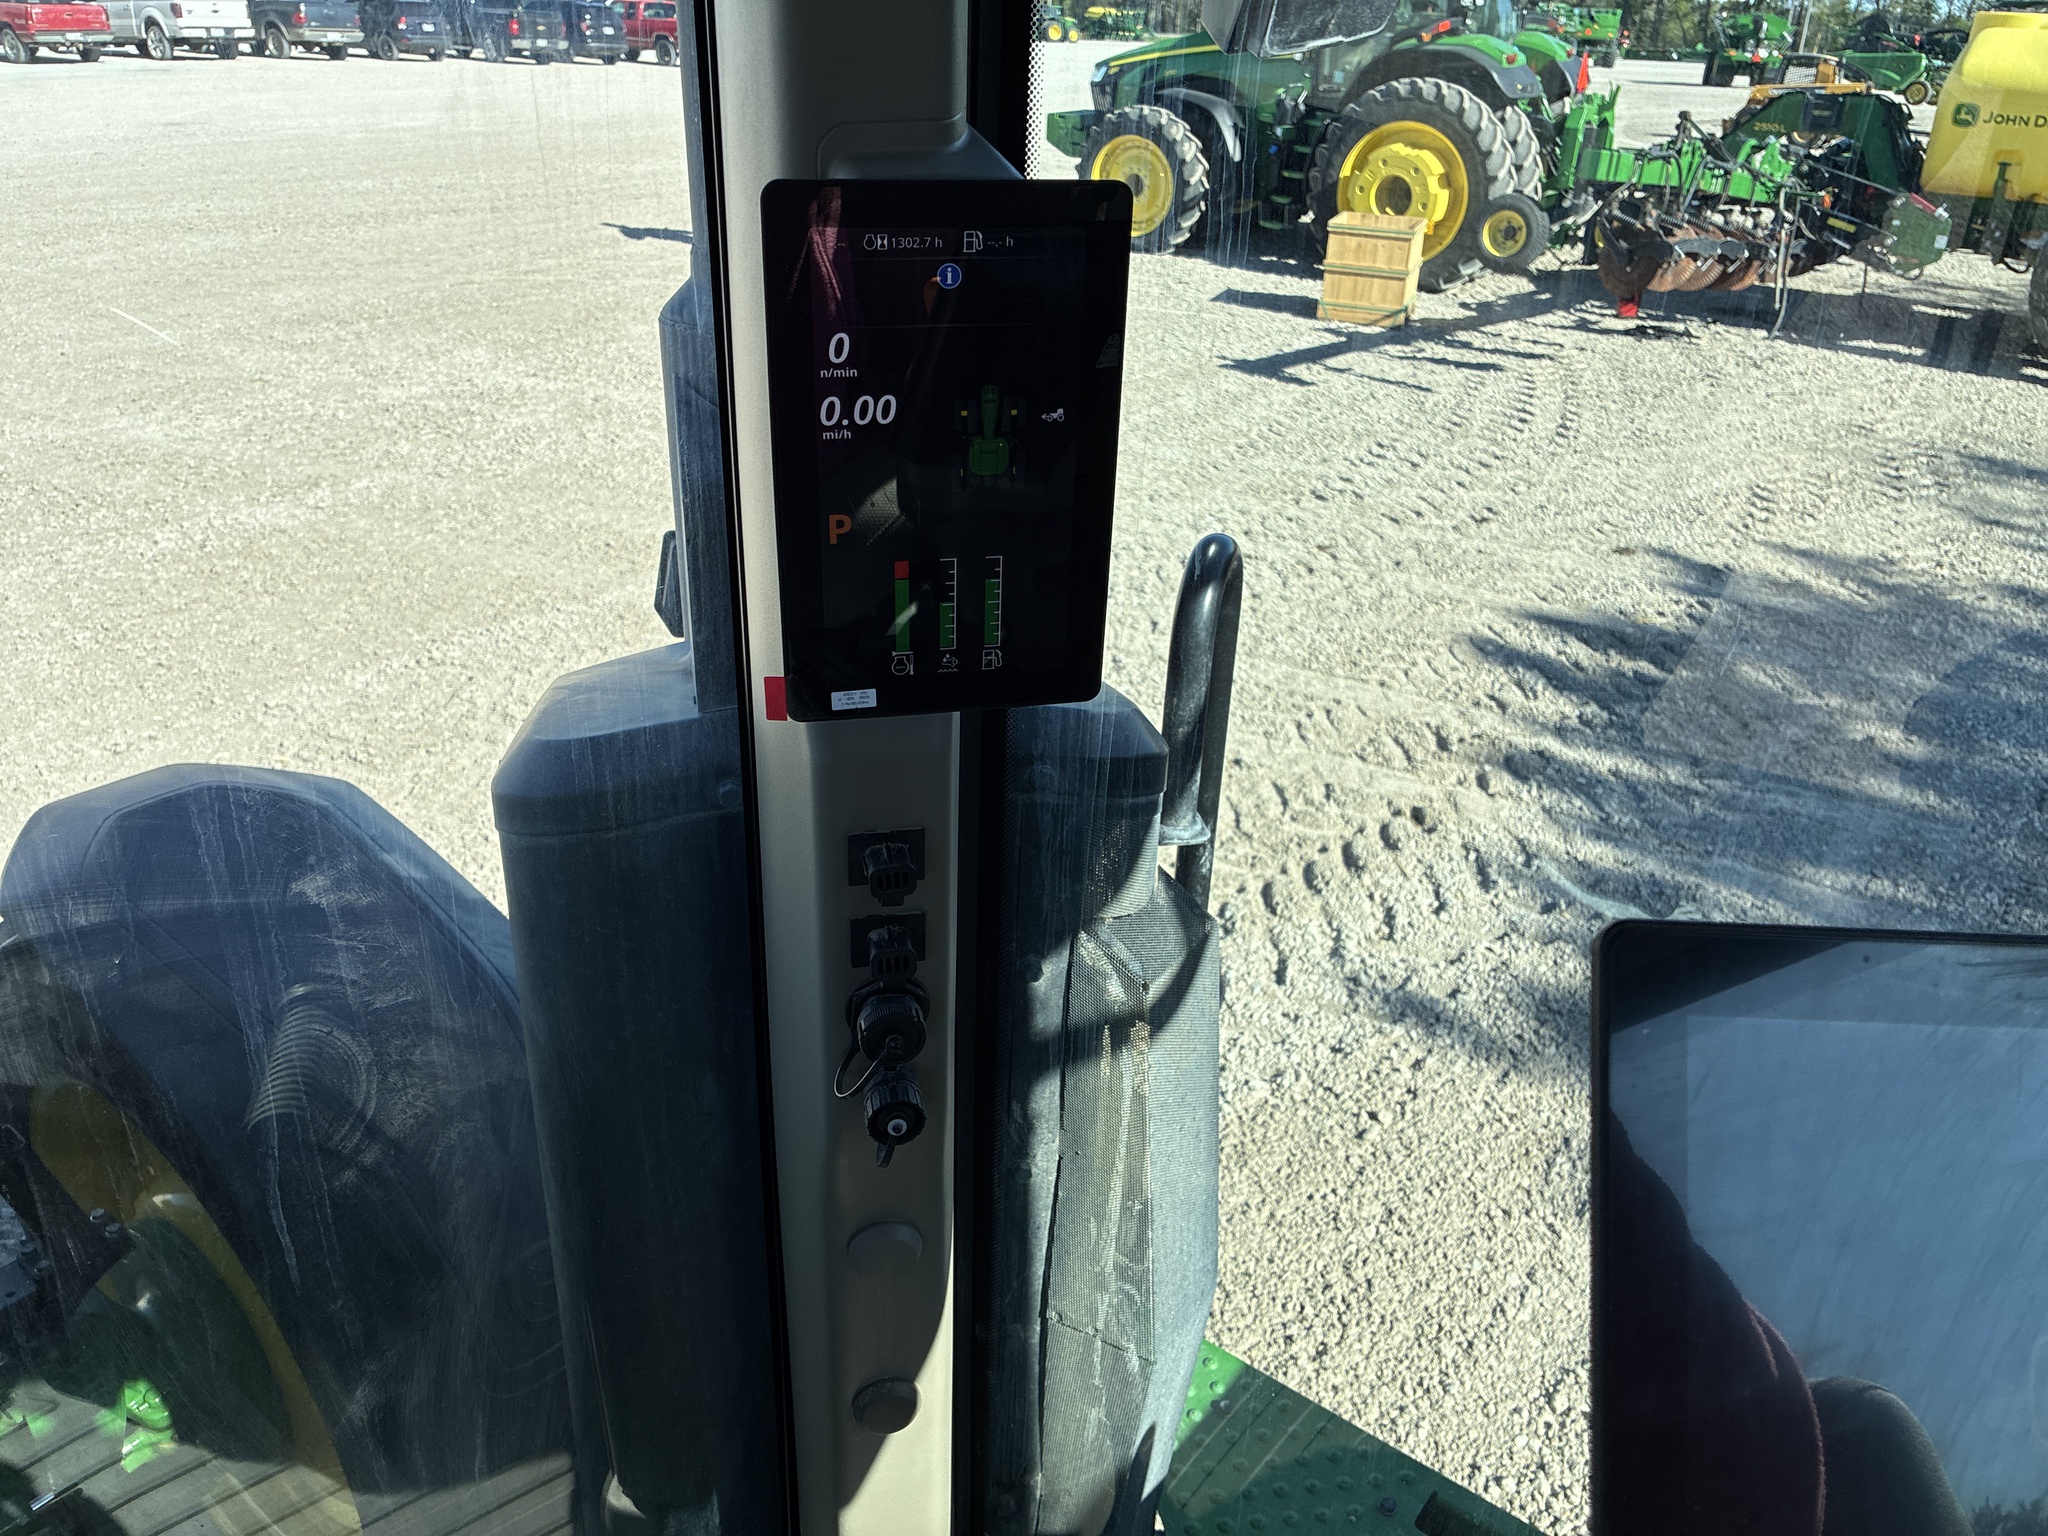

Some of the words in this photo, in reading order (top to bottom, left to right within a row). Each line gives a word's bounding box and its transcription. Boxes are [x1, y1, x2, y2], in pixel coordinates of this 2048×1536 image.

[1983, 111, 2030, 127] JOHN
[891, 237, 932, 249] 1302.7
[935, 236, 943, 248] h
[1006, 236, 1014, 247] h
[828, 332, 850, 364] 0
[820, 367, 858, 378] n/min
[820, 394, 897, 426] 0.00
[822, 429, 852, 440] mi/h
[828, 514, 852, 545] P
